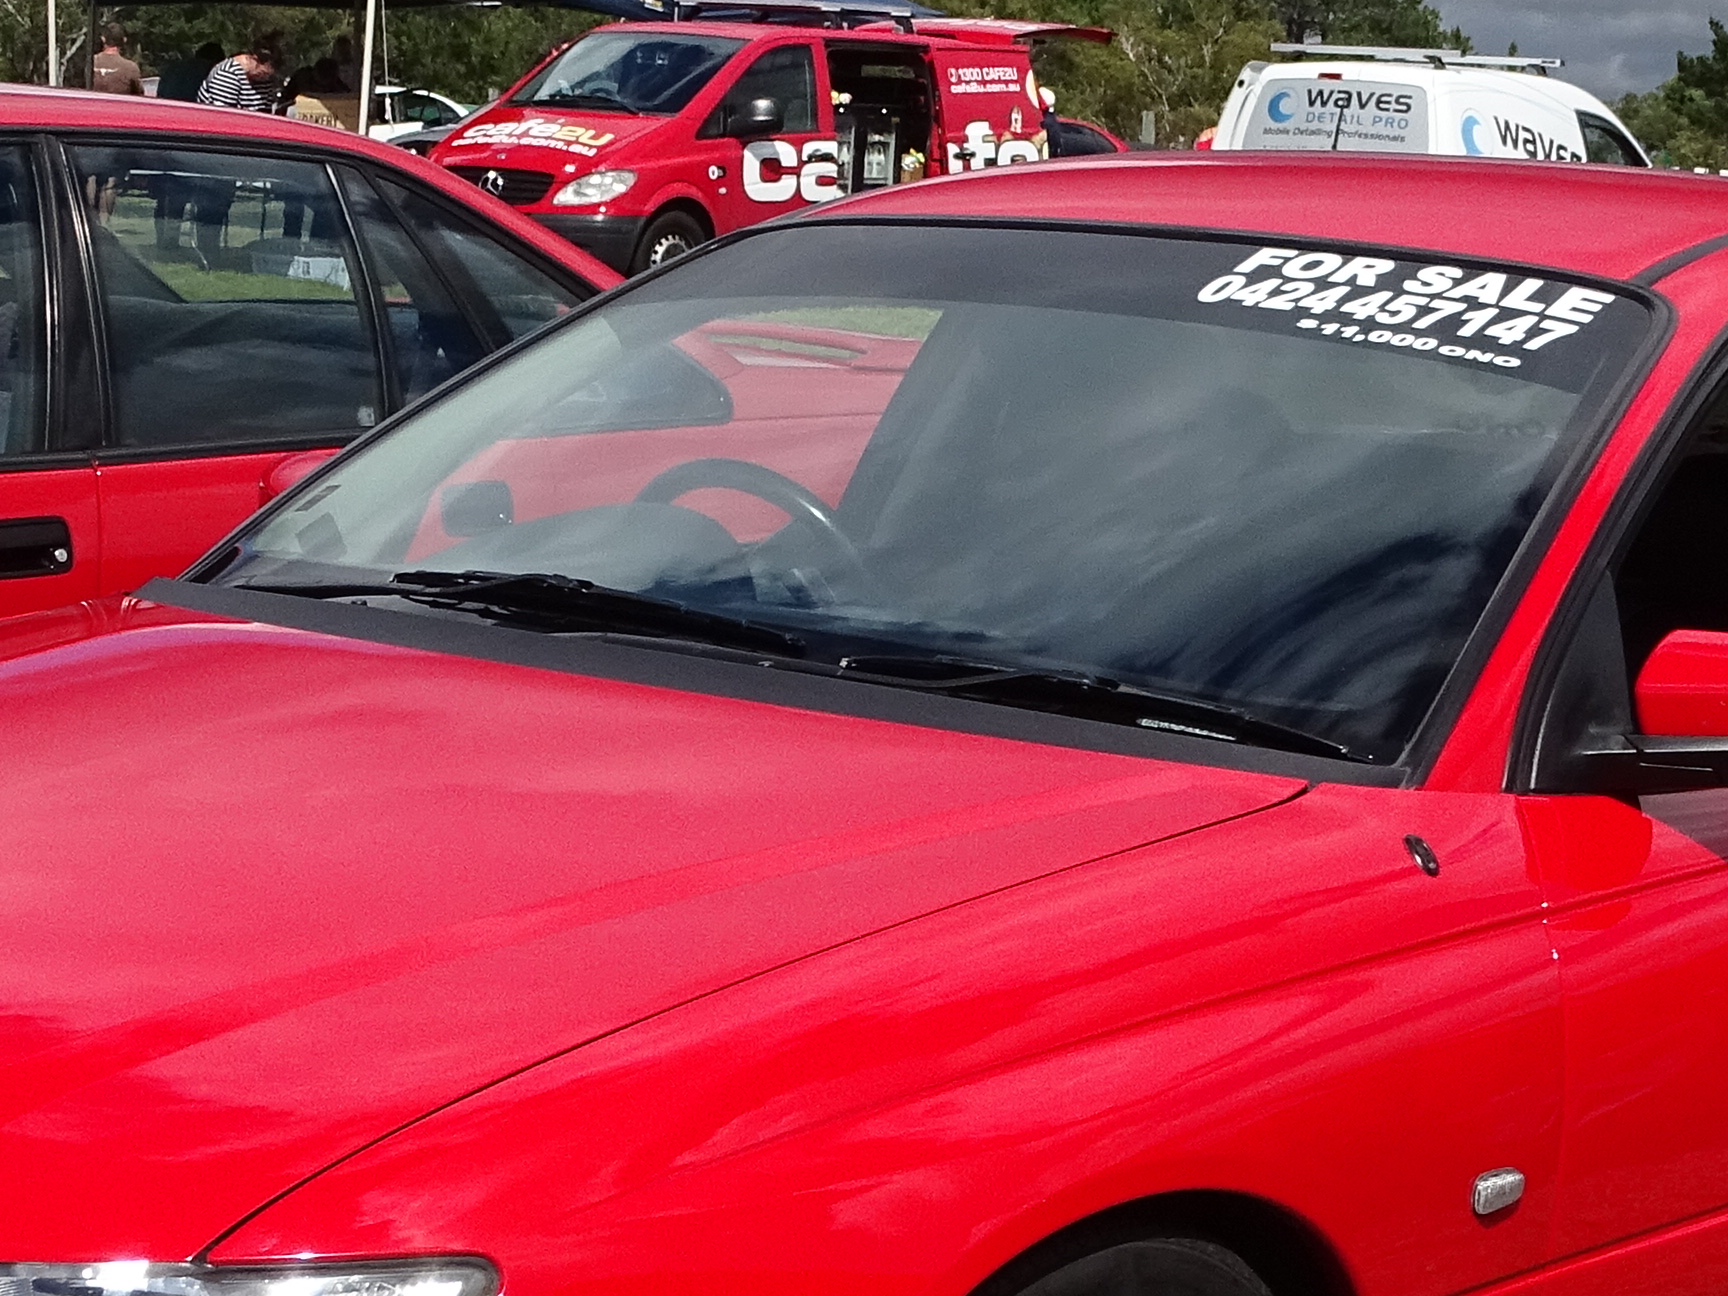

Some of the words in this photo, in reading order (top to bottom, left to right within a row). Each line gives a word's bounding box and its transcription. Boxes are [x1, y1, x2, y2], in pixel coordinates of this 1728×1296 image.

[1305, 111, 1364, 126] DETAIL
[1372, 115, 1409, 130] PRO
[1232, 247, 1396, 287] FOR
[1402, 264, 1617, 325] SALE
